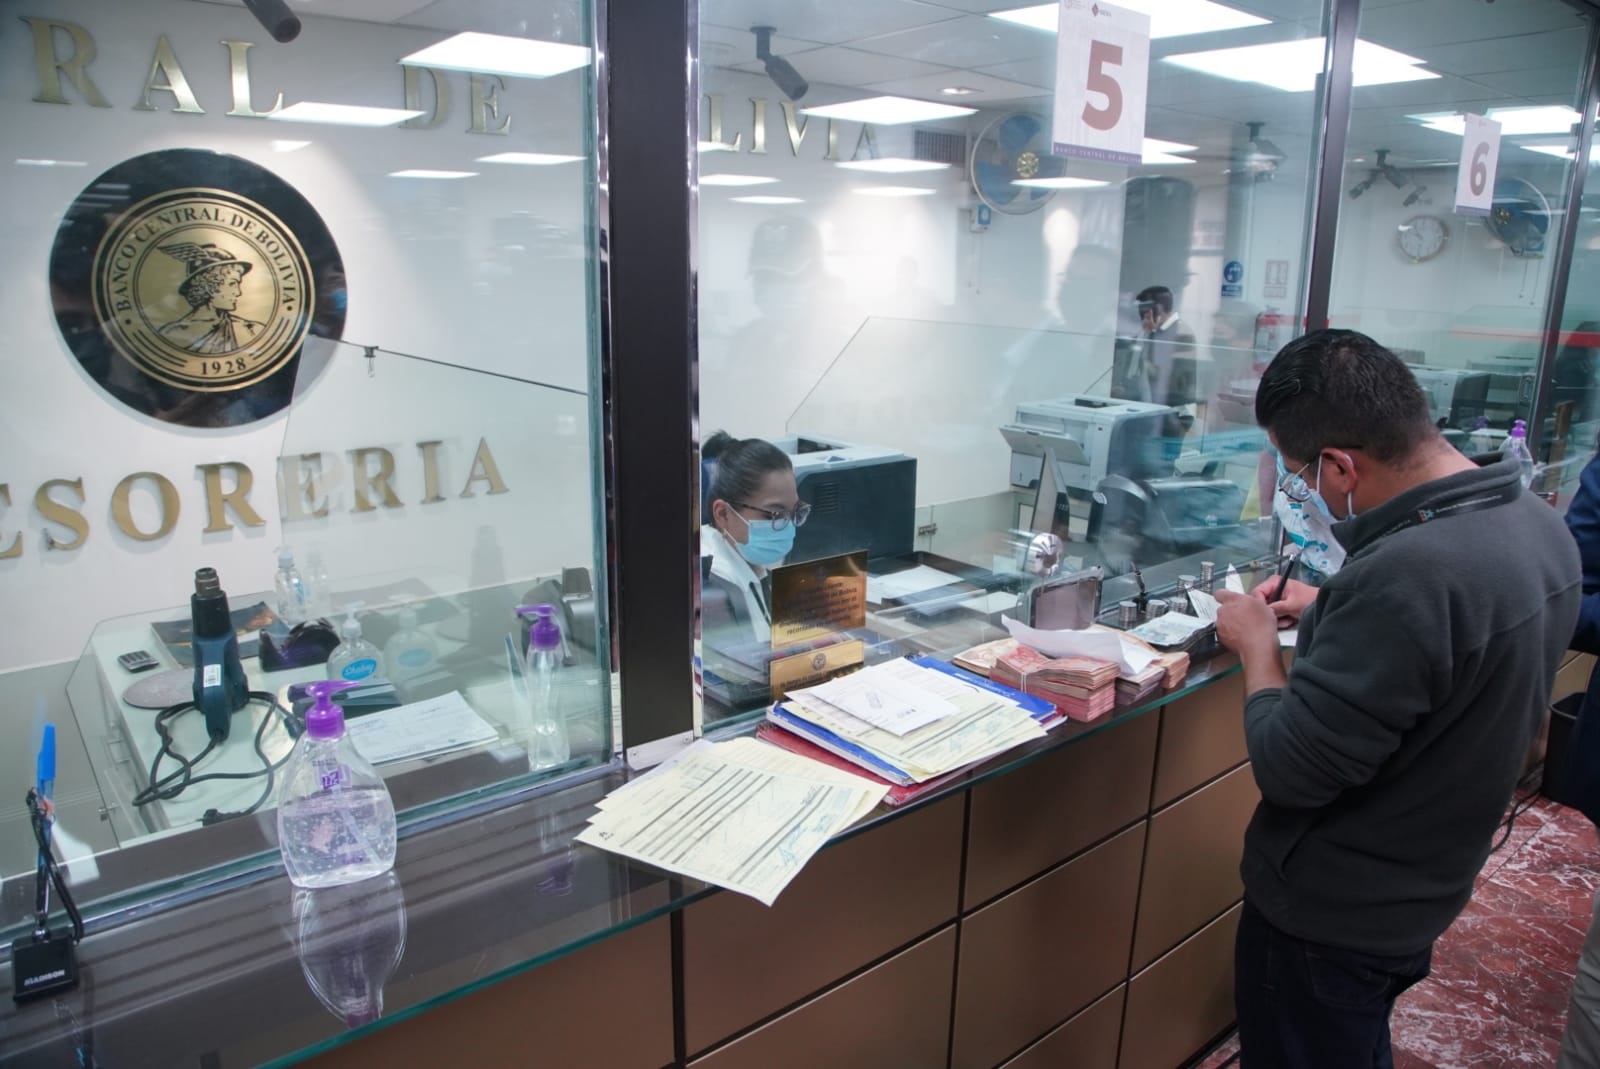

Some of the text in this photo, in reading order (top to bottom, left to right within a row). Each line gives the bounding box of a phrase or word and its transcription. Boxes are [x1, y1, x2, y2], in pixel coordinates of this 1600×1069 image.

[396, 61, 511, 136] DE
[1081, 40, 1123, 131] 5
[1470, 142, 1489, 196] 6
[112, 207, 297, 313] BANCO CENTRAL DE BOLIVIA
[201, 357, 246, 376] 1928
